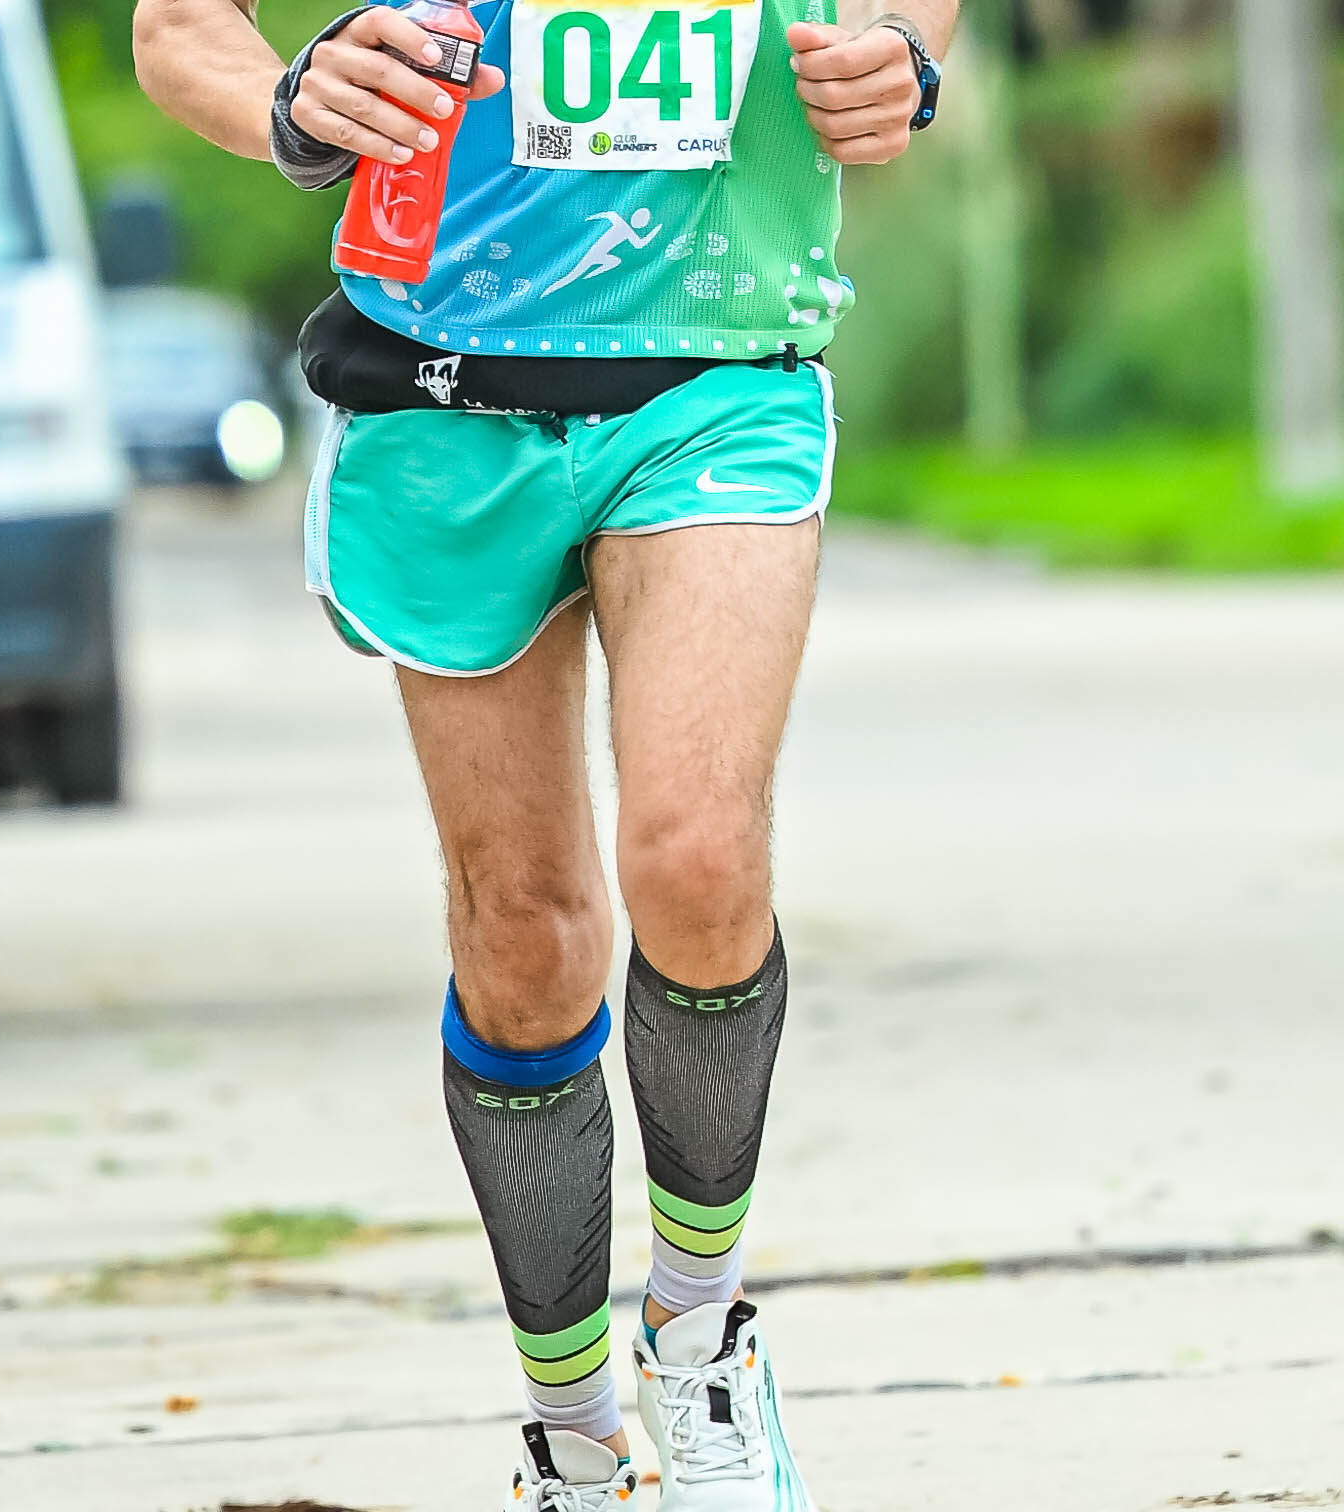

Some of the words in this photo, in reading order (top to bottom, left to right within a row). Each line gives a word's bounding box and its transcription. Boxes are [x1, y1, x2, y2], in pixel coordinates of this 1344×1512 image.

[542, 9, 733, 124] 041
[613, 134, 637, 144] CLUB
[666, 983, 762, 1011] SOX
[475, 1079, 576, 1110] SOX
